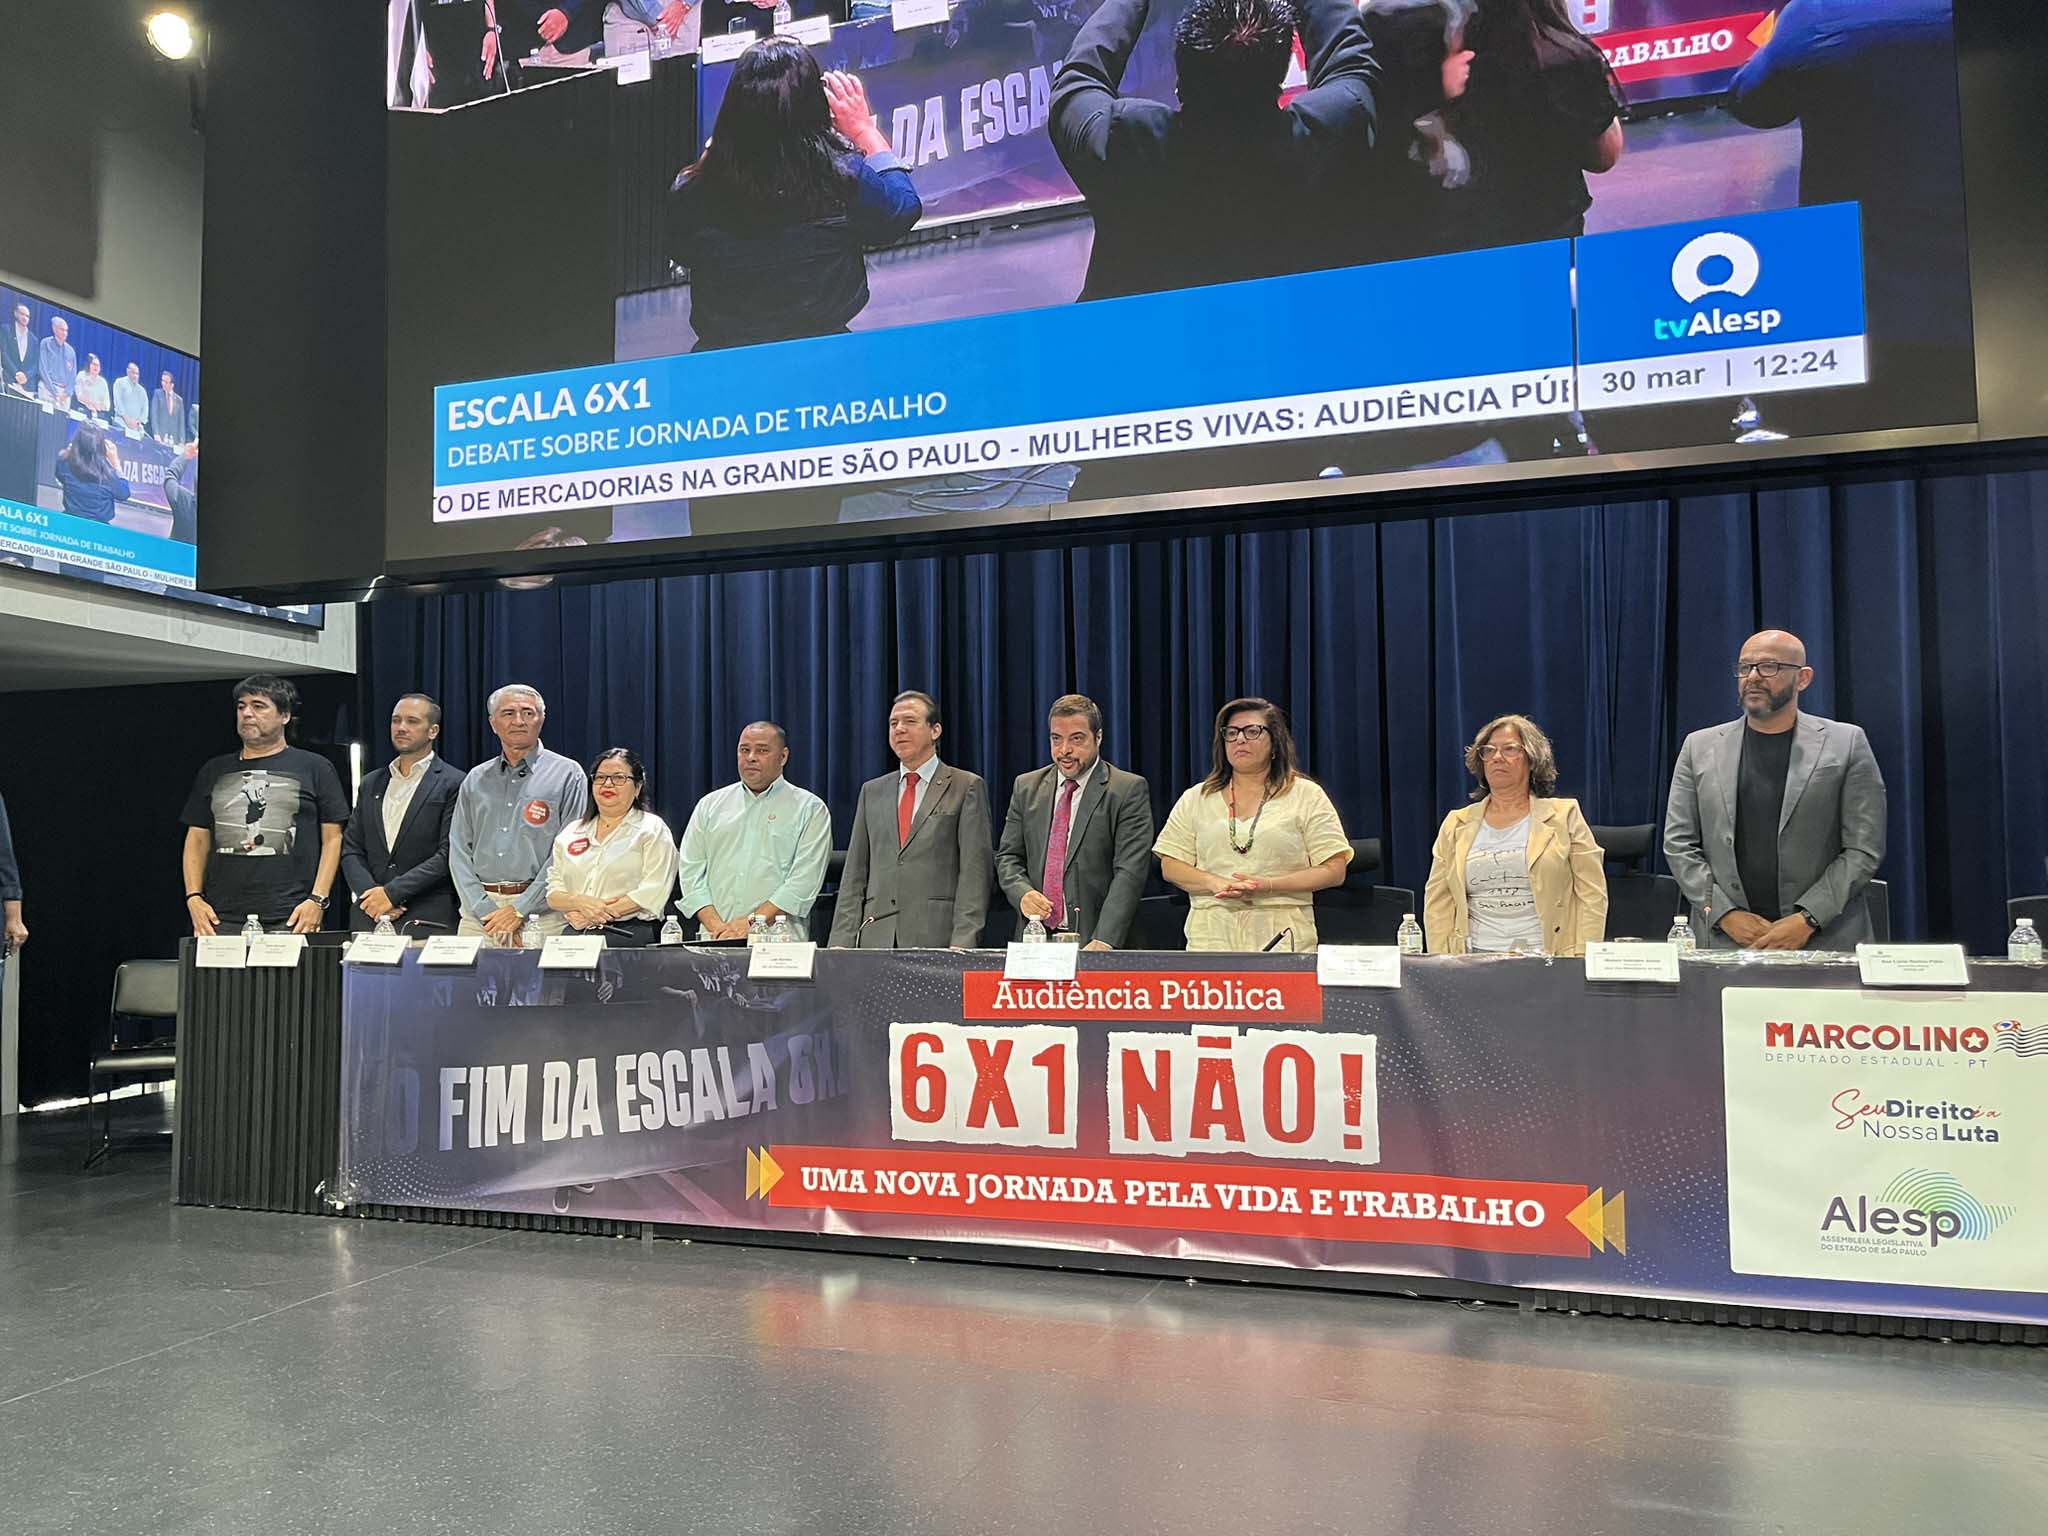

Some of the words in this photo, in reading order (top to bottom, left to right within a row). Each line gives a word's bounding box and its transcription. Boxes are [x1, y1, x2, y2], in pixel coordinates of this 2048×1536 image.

[892, 96, 949, 167] DA
[1654, 308, 1781, 340] tvAlesp
[1602, 370, 1636, 393] 30
[1647, 367, 1705, 390] mar
[1753, 349, 1838, 378] 12:24
[448, 387, 577, 431] ESCALA
[583, 377, 651, 415] 6X1
[448, 437, 537, 468] DEBATE
[541, 428, 620, 457] SOBRE
[625, 414, 749, 449] JORNADA
[755, 409, 790, 434] DE
[795, 391, 947, 430] TRABALHO
[461, 491, 490, 512] DE
[498, 471, 673, 509] MERCADORIAS
[682, 468, 716, 491] NA
[724, 456, 833, 486] GRANDE
[842, 447, 898, 475] SÃO
[908, 439, 1000, 470] PAULO
[1029, 418, 1193, 457] MULHERES
[1203, 407, 1304, 438] VIVAS:
[1314, 385, 1502, 428] AUDIÊNCIA
[26, 511, 48, 527] 6X1
[10, 523, 38, 537] SOBRE
[40, 531, 79, 546] JORNADA
[80, 539, 92, 551] DE
[93, 542, 135, 559] TRABALHO
[57, 551, 68, 561] NA
[70, 554, 102, 569] GRANDE
[123, 565, 148, 578] PAULO
[155, 572, 193, 588] MULHERES
[992, 980, 1152, 1010] Audiência
[1160, 981, 1285, 1011] Pública
[1765, 1022, 1989, 1052] MARCOLINO
[1765, 1052, 1852, 1064] DEPUTADO
[1861, 1055, 1945, 1068] ESTADUAL
[1968, 1059, 1988, 1069] PT
[439, 1063, 528, 1152] FIM
[542, 1058, 603, 1142] DA
[615, 1042, 777, 1134] ESCALA
[900, 1032, 1066, 1135] 6X1
[1121, 1036, 1363, 1150] NÃO!
[1886, 1099, 1975, 1120] Direito
[1863, 1120, 1938, 1140] Nossa
[1942, 1123, 1999, 1142] Luta
[801, 1167, 868, 1193] UMA
[874, 1170, 960, 1199] NOVA
[966, 1173, 1117, 1204] JORNADA
[1124, 1180, 1211, 1208] PELA
[1214, 1183, 1303, 1214] VIDA
[1310, 1189, 1333, 1215] E
[1338, 1190, 1545, 1228] TRABALHO
[1821, 1195, 1961, 1247] Alesp
[1821, 1235, 1870, 1245] ASSEMBLEIA
[1872, 1238, 1924, 1248] LEGISLATIVA
[1821, 1243, 1833, 1251] DO
[1835, 1245, 1867, 1253] ESTADO
[1868, 1246, 1880, 1254] DE
[1881, 1246, 1898, 1255] SÃO
[1899, 1249, 1927, 1257] PAULO
